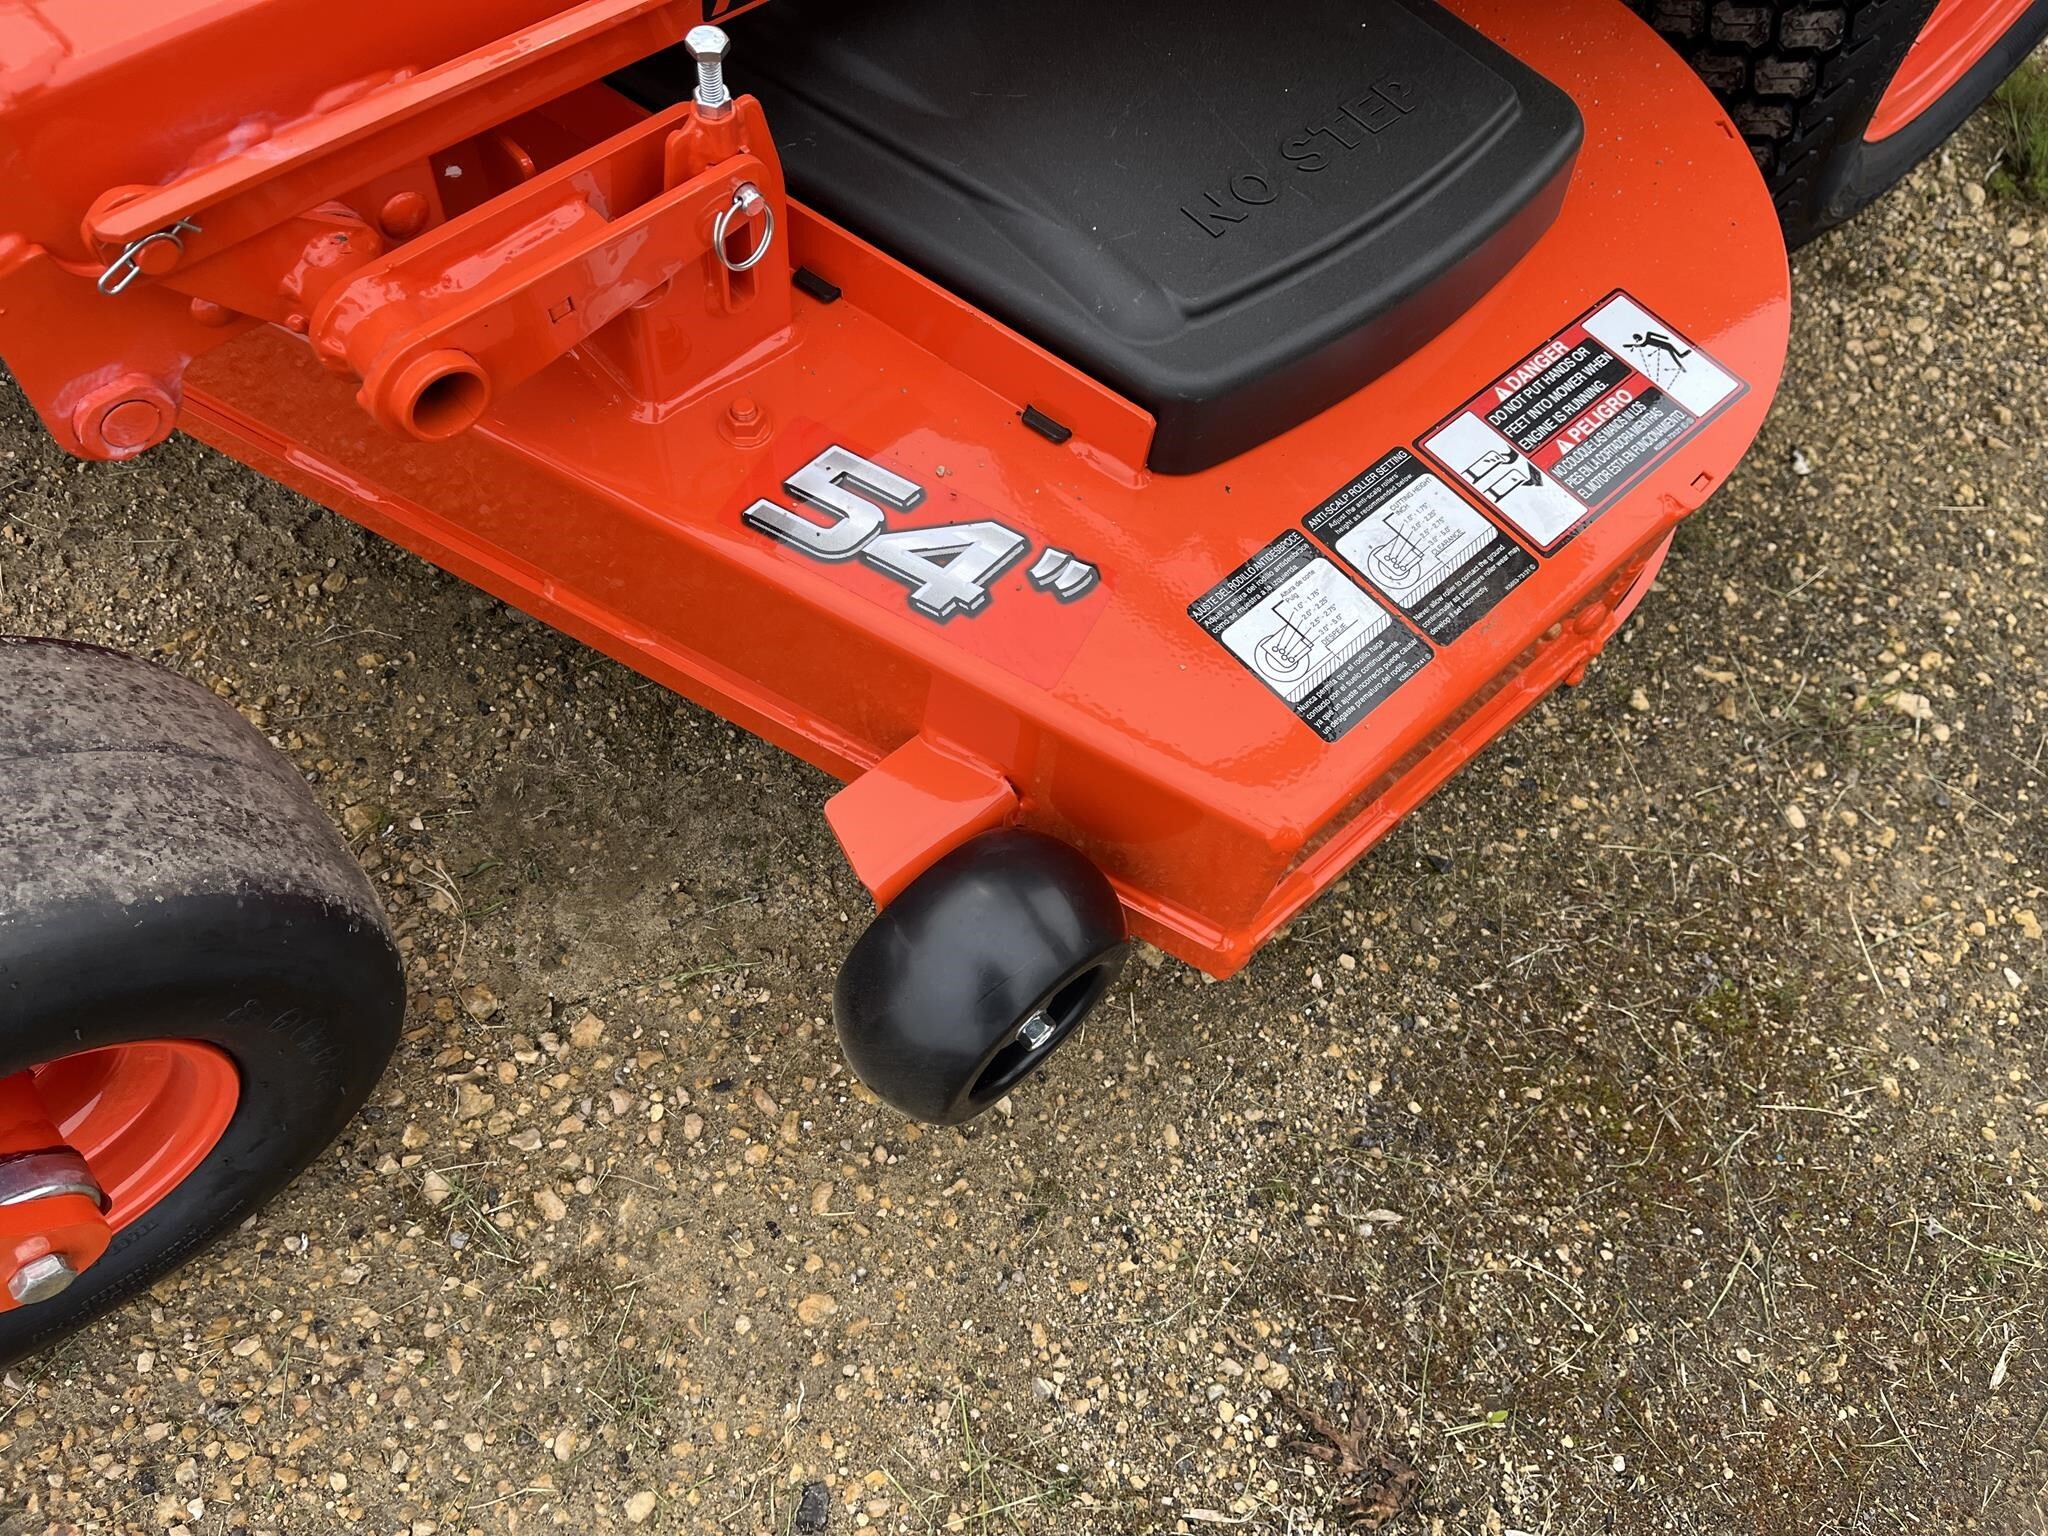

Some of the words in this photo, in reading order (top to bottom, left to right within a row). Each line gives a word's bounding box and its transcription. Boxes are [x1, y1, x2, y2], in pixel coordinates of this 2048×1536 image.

[1180, 174, 1279, 239] NO
[1280, 80, 1417, 173] STEP
[1490, 408, 1508, 424] DO
[1502, 393, 1527, 414] NOT
[1522, 379, 1546, 399] PUT
[1540, 356, 1576, 385] HANDS
[1570, 345, 1591, 362] OR
[1503, 339, 1570, 391] DANGER
[1504, 414, 1532, 437] FEET
[1526, 397, 1554, 419] INTO
[1547, 371, 1587, 403] MOWER
[1581, 351, 1613, 377] WHEN
[1518, 417, 1558, 450] ENGINE
[1552, 410, 1567, 423] IS
[1561, 377, 1609, 415] RUNNING.
[1566, 387, 1634, 442] PELIGRO
[1589, 431, 1607, 447] LAS
[1600, 415, 1628, 438] MANOS
[1621, 409, 1635, 421] NI
[1627, 400, 1647, 416] LOS
[1551, 463, 1568, 478] NO
[1561, 441, 1595, 470] COLOQUE
[1564, 470, 1585, 488] PIES
[1578, 463, 1593, 477] EN
[1587, 457, 1601, 469] LA
[1594, 428, 1637, 463] CORTADORA
[1629, 406, 1664, 435] MIENTRAS
[1577, 486, 1592, 499] EL
[1585, 468, 1613, 492] MOTOR
[1604, 454, 1629, 475] ESTÁ
[1622, 448, 1637, 462] EN
[1630, 408, 1687, 455] FUNCIONAMIENTO.
[1306, 493, 1352, 528] ANTI-SCALP
[1347, 472, 1379, 496] ROLLER
[1374, 449, 1408, 475] SETTING
[1334, 519, 1355, 535] height
[1352, 513, 1361, 521] as
[1358, 485, 1398, 515] recommended
[1394, 472, 1414, 487] below.
[1388, 491, 1414, 511] CUTTING
[1411, 476, 1432, 493] HEIGHT
[1191, 595, 1219, 618] AJUSTE
[1214, 585, 1231, 600] DEL
[1226, 565, 1257, 590] RODILLO
[1252, 531, 1301, 570] ANTIDESBROCE
[1430, 528, 1463, 555] CLEARANCE
[1203, 609, 1225, 627] Adjust
[1221, 604, 1231, 612] la
[1228, 590, 1248, 607] altura
[1245, 583, 1257, 593] del
[1254, 569, 1275, 586] rodillo
[1272, 542, 1310, 572] antidesbroce
[1412, 605, 1431, 621] Never
[1428, 594, 1444, 608] allow
[1441, 584, 1457, 597] roller
[1459, 565, 1480, 582] contact
[1477, 558, 1488, 567] the
[1485, 544, 1506, 561] ground
[1420, 600, 1454, 628] continuously
[1458, 574, 1486, 597] premature
[1482, 564, 1497, 576] roller
[1495, 554, 1509, 566] wear
[1507, 545, 1521, 557] may
[1320, 622, 1348, 645] DESPEJE
[1296, 694, 1318, 712] Nunca
[1314, 677, 1339, 698] permita
[1335, 669, 1349, 681] que
[1345, 663, 1355, 671] el
[1351, 650, 1371, 666] rodillo
[1368, 638, 1386, 653] haga
[1304, 697, 1331, 720] contacto
[1328, 689, 1341, 700] con
[1338, 683, 1347, 691] el
[1344, 671, 1362, 686] suelo
[1358, 639, 1402, 674] continuamente,
[1313, 718, 1324, 728] ya
[1321, 709, 1336, 722] que
[1332, 702, 1342, 711] un
[1339, 688, 1359, 705] ajuste
[1355, 666, 1385, 691] incorrecto
[1381, 652, 1402, 670] puede
[1398, 638, 1418, 654] causar
[1321, 725, 1332, 734] un
[1328, 704, 1357, 728] desgaste
[1353, 681, 1384, 707] prematuro
[1380, 673, 1392, 684] del
[1388, 659, 1409, 676] rodillo.
